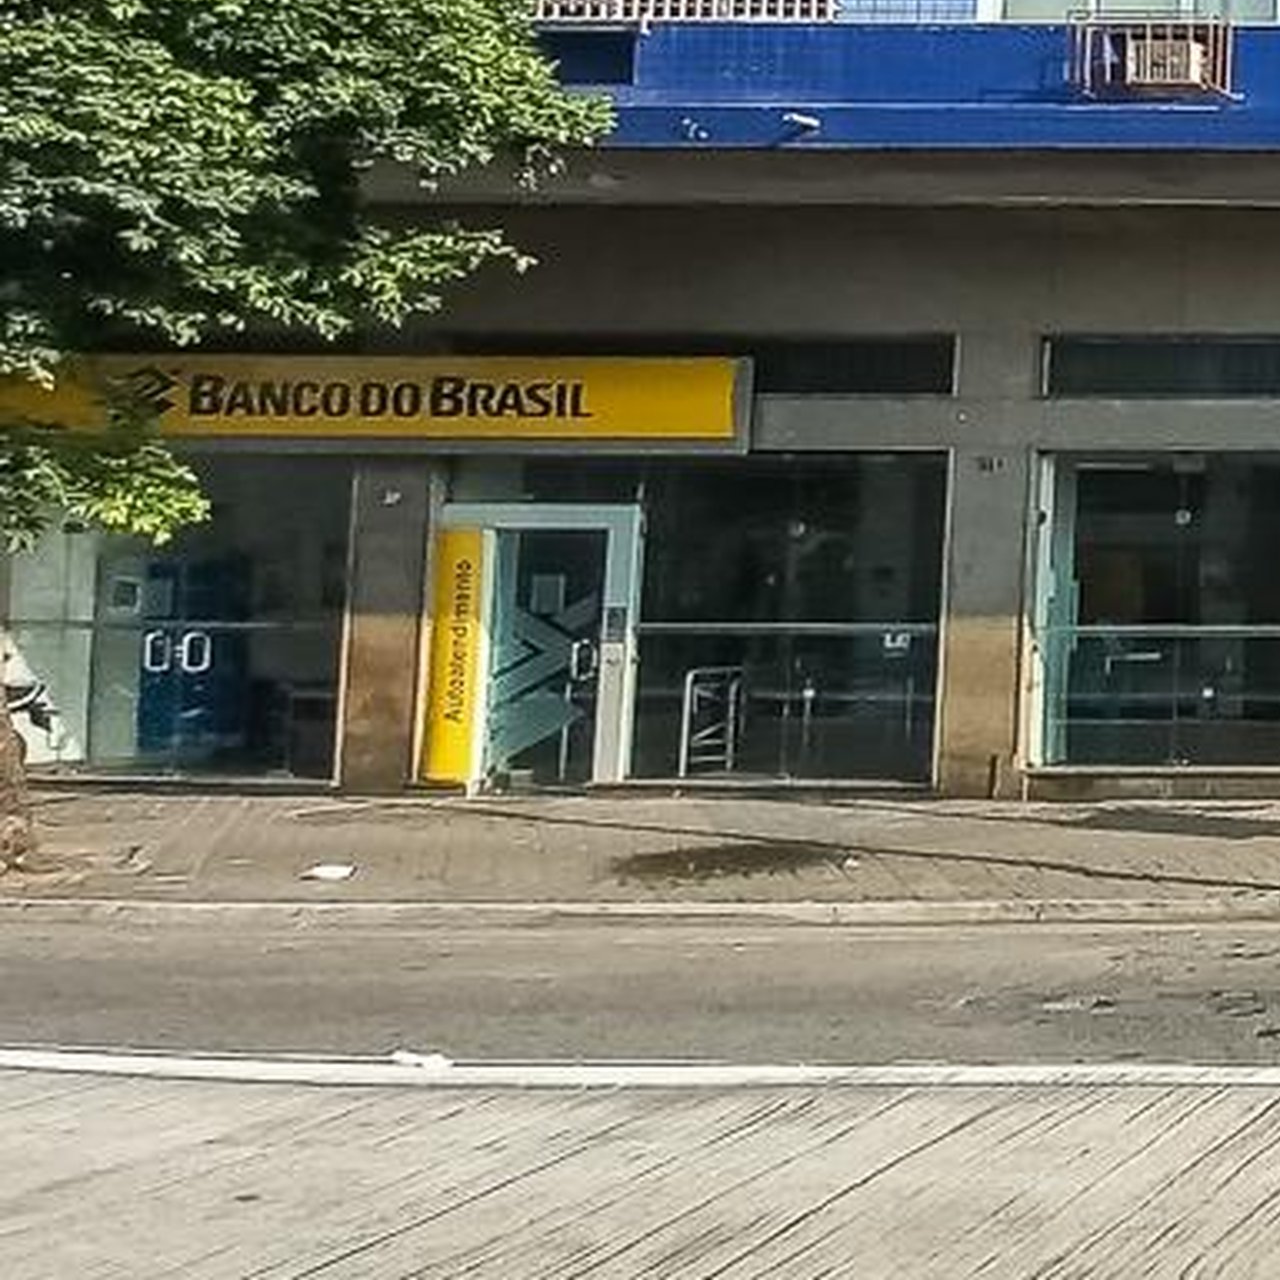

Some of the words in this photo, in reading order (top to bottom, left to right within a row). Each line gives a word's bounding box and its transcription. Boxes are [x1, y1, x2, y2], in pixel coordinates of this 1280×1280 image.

[188, 373, 350, 419] BANCO
[356, 381, 421, 419] DO
[429, 376, 592, 419] BRASIL
